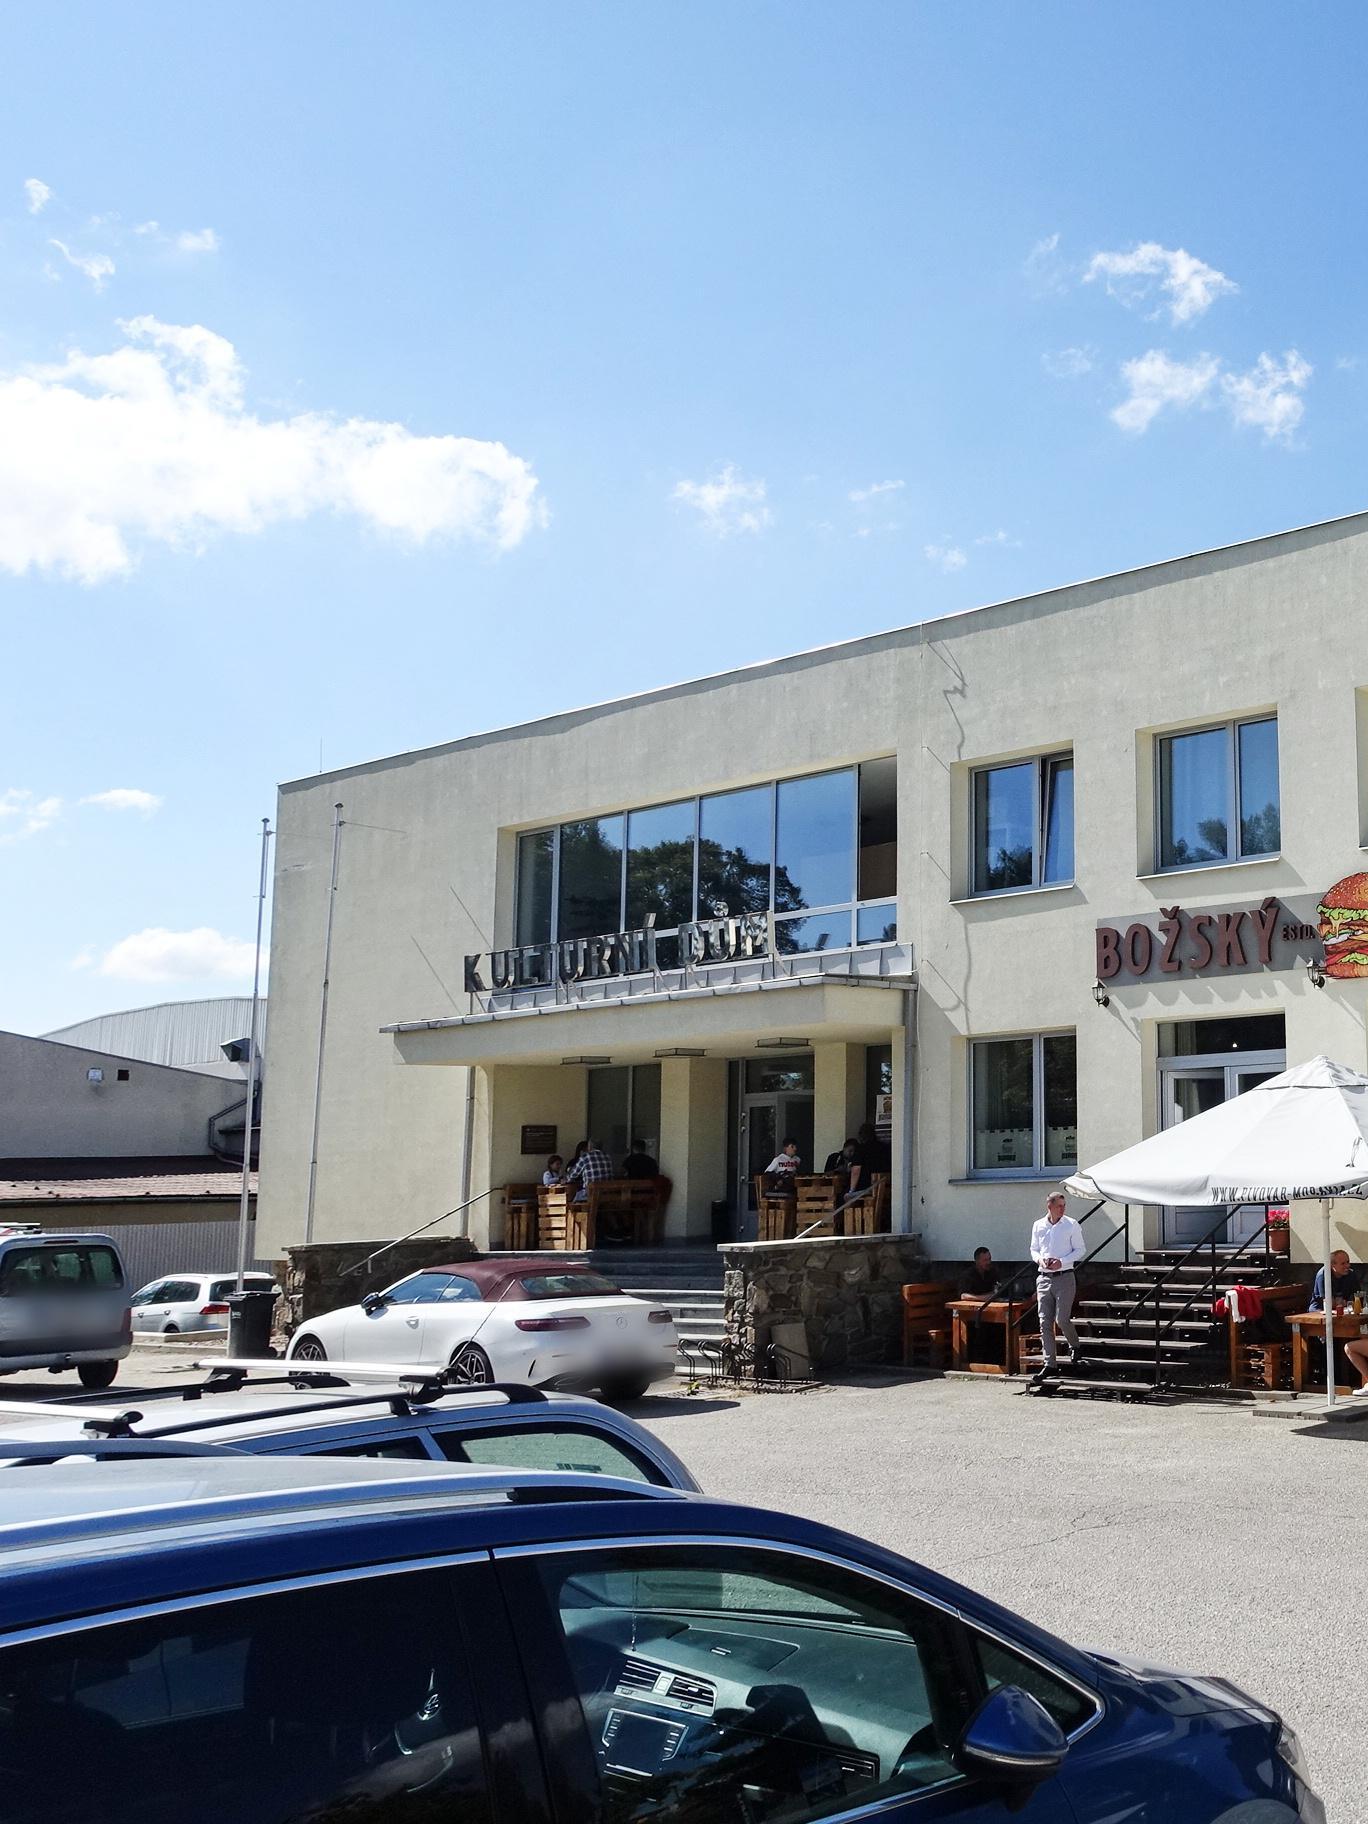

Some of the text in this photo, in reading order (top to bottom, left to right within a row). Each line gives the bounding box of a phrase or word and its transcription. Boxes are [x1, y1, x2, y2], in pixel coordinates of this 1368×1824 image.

[464, 901, 775, 993] KULTURNÍ DŮM
[1096, 897, 1280, 979] BOŽSKÝ
